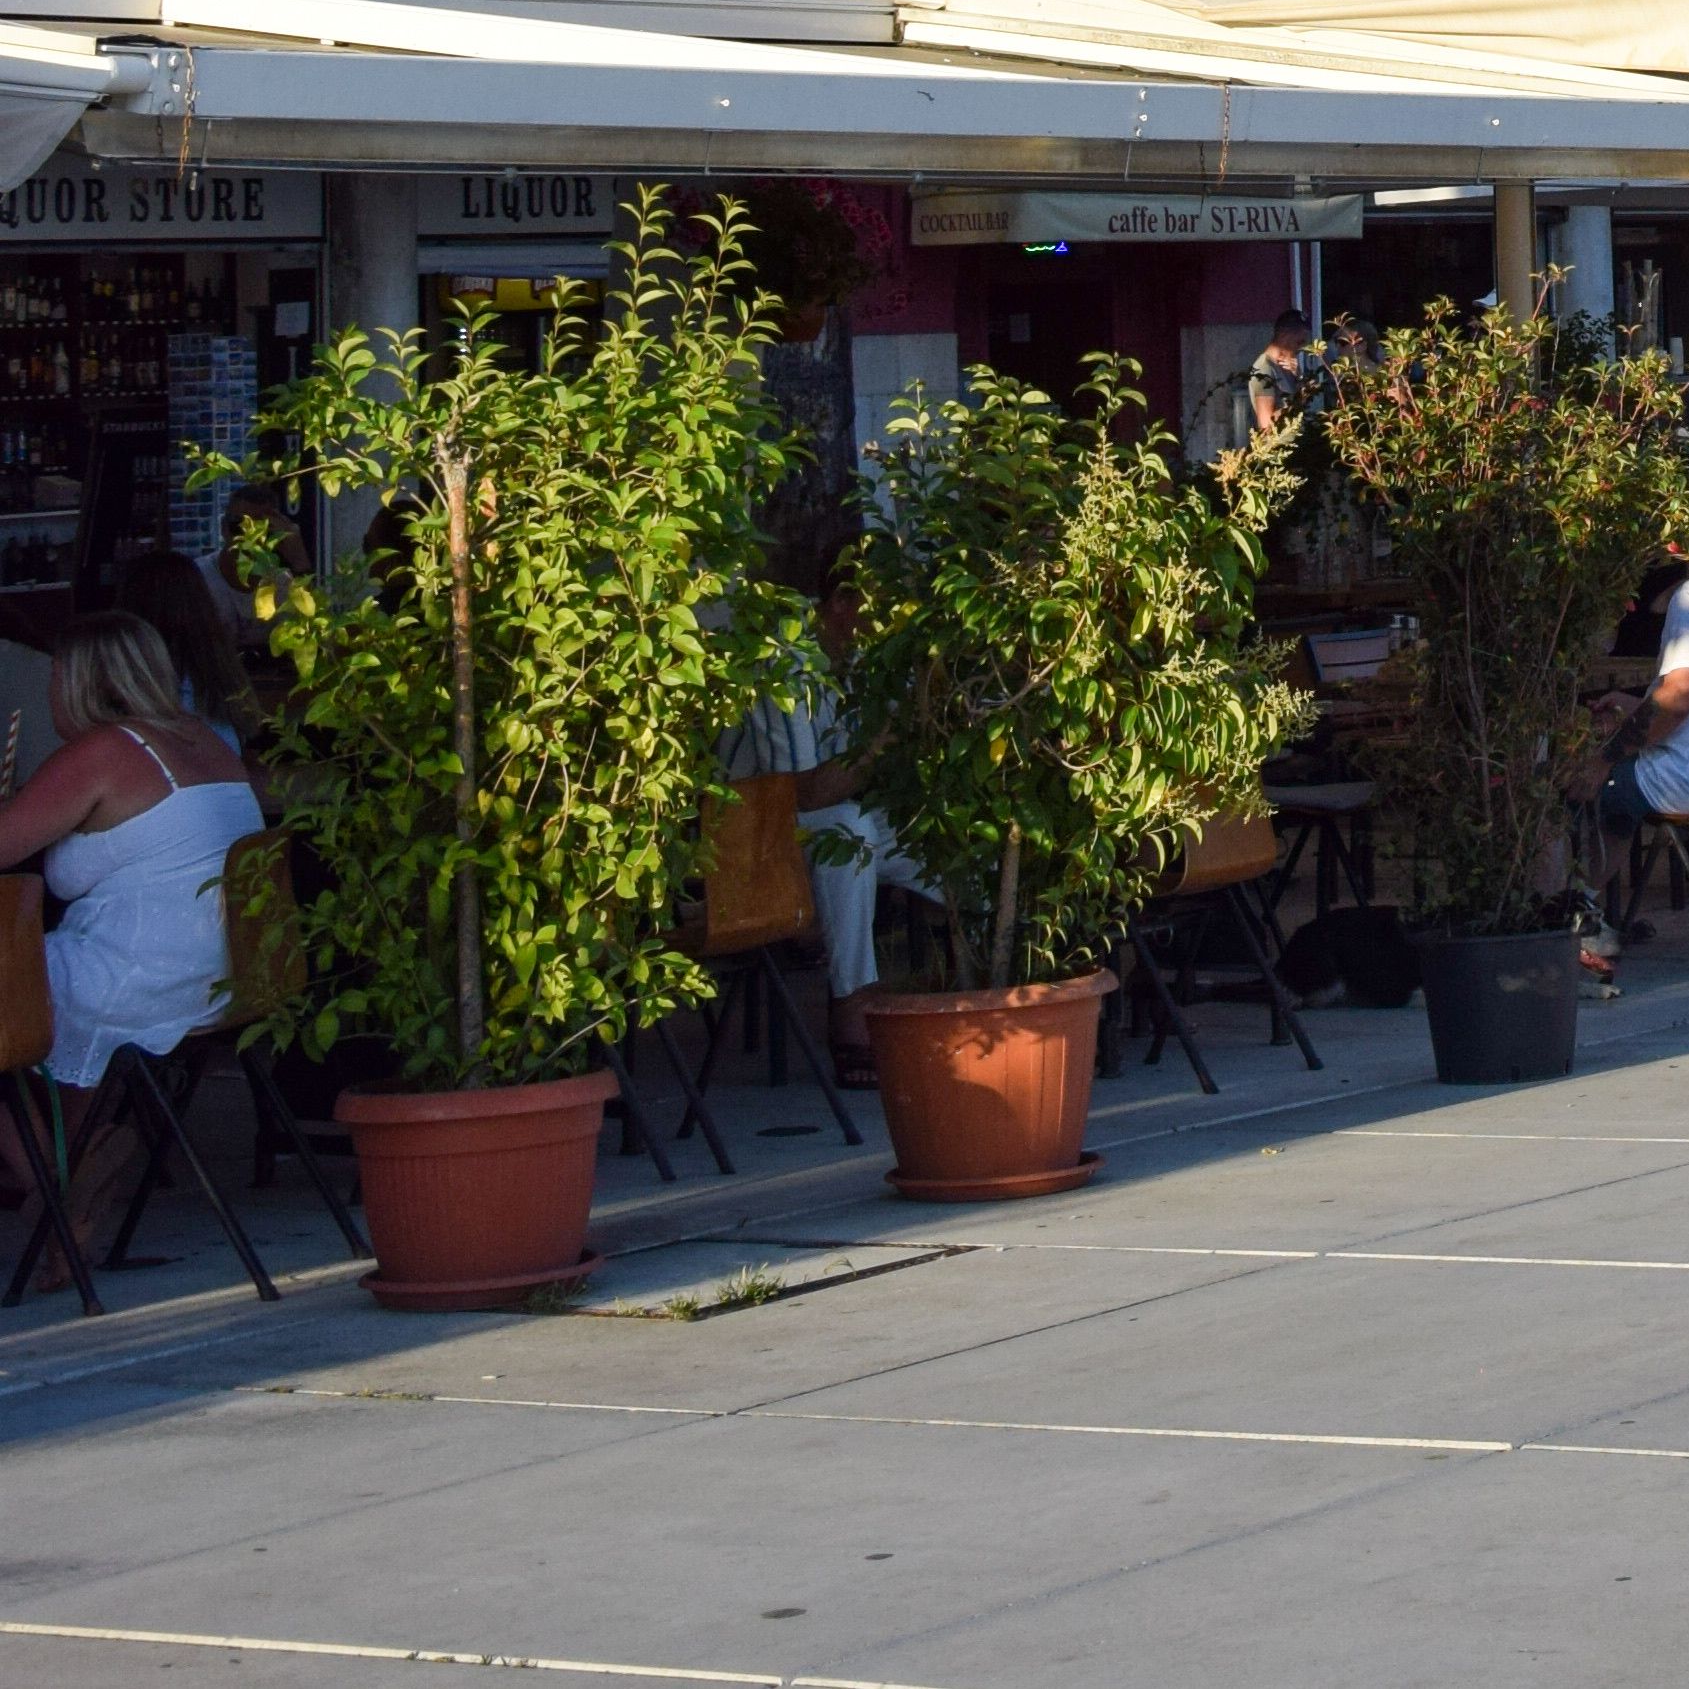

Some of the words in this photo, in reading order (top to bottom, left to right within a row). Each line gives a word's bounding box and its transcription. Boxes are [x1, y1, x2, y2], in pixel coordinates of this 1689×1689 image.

[129, 176, 265, 223] STORE
[461, 176, 597, 223] LIQUOR
[919, 211, 984, 235] COCKTAIL
[984, 210, 1010, 233] BAR
[1107, 205, 1158, 235] caffe
[1164, 206, 1200, 235] bar
[1210, 205, 1302, 233] ST-RIVA
